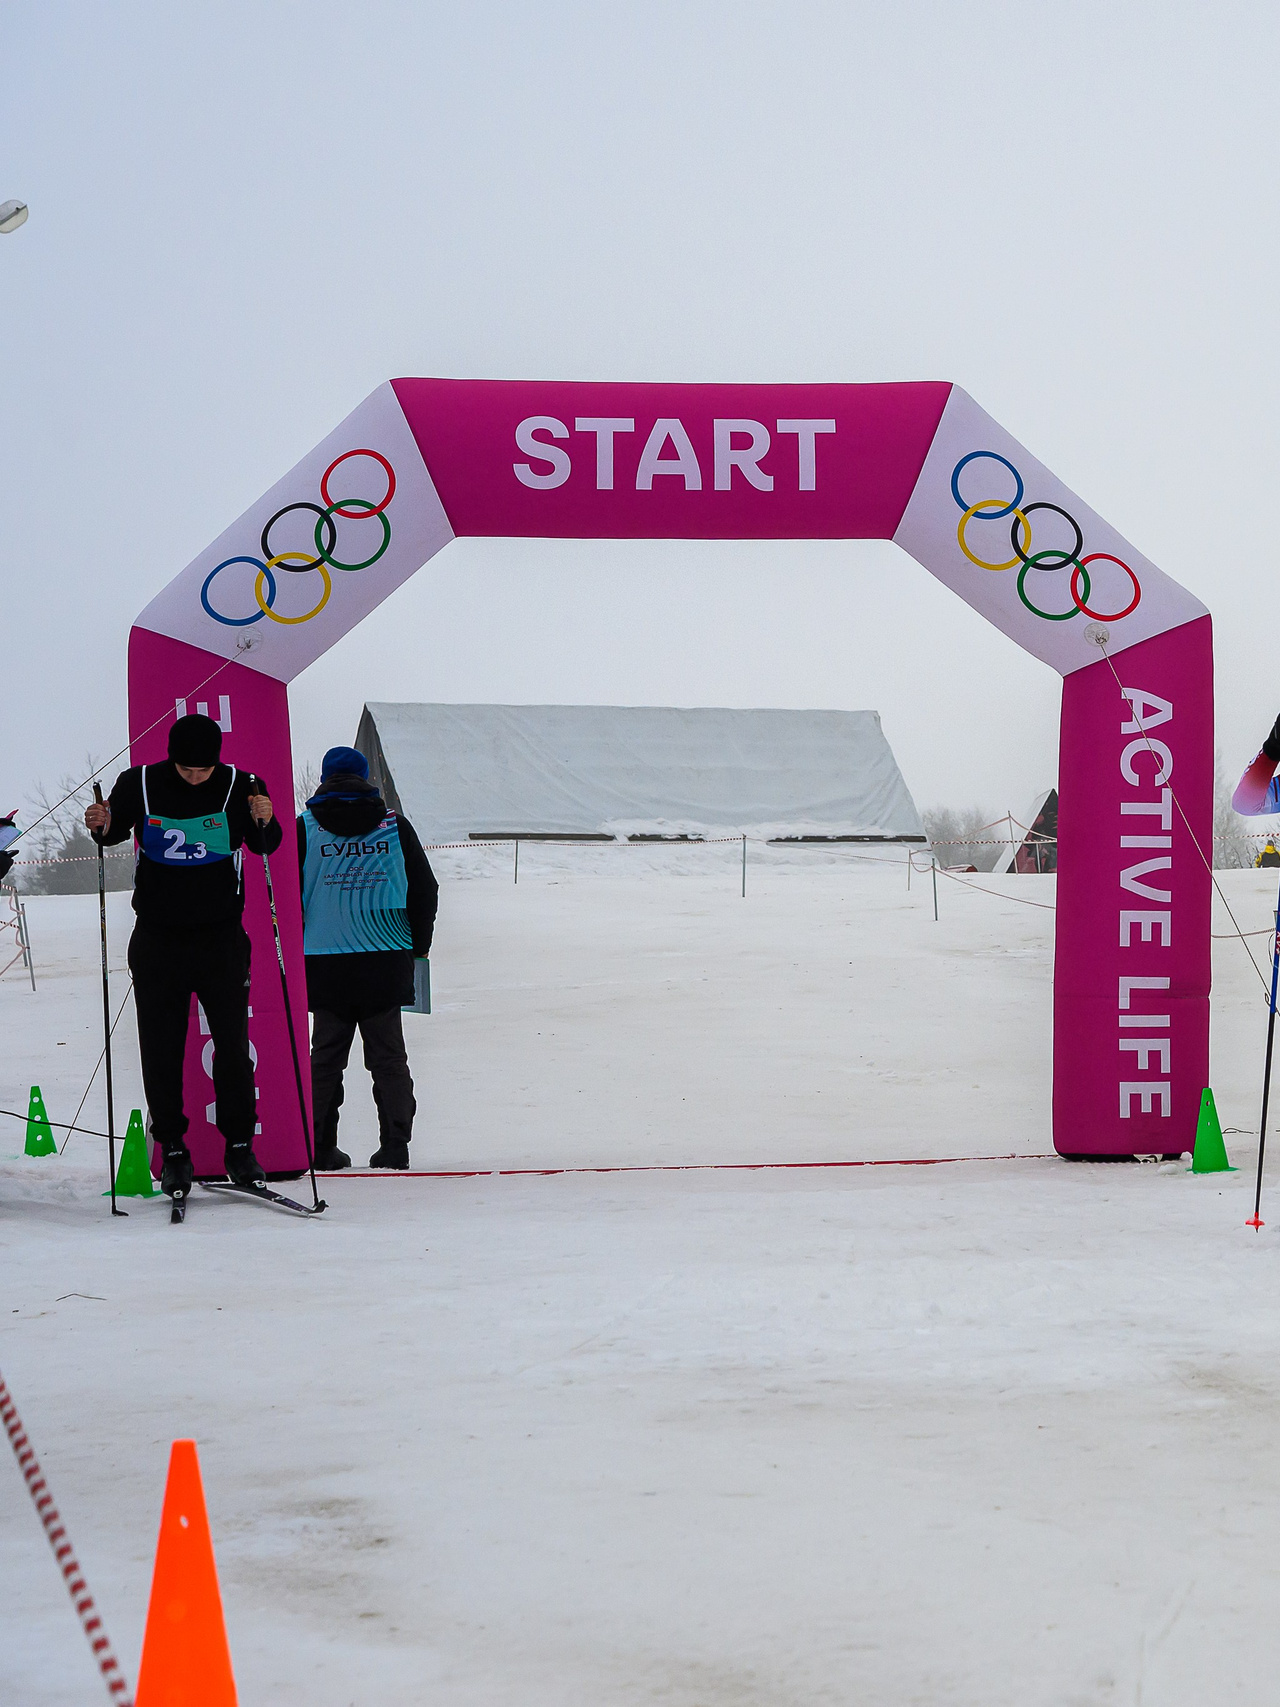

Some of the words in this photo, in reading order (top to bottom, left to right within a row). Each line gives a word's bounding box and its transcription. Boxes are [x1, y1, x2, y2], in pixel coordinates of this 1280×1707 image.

[513, 415, 836, 492] START
[163, 828, 207, 860] 2.3
[320, 840, 390, 858] СУДЬЯ
[1119, 687, 1174, 947] ACTIVE
[1118, 977, 1171, 1119] LIFE
